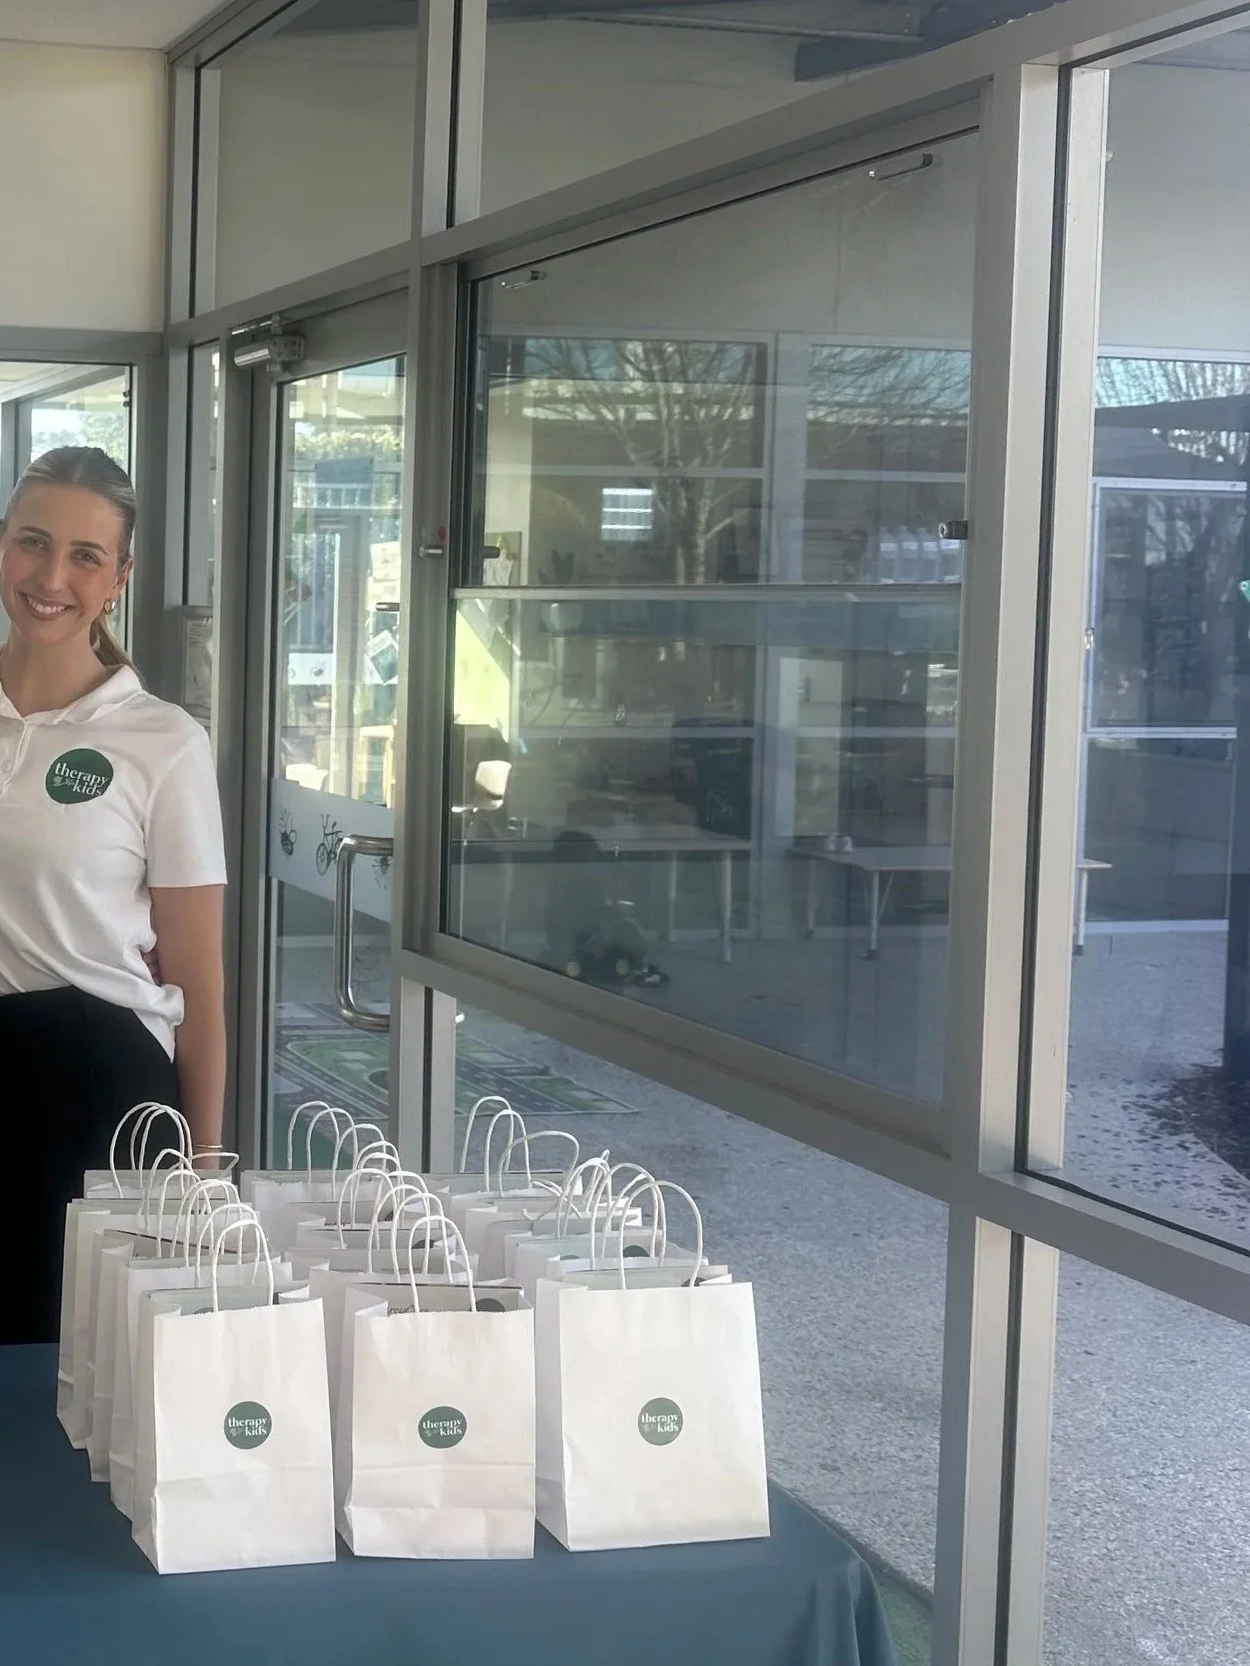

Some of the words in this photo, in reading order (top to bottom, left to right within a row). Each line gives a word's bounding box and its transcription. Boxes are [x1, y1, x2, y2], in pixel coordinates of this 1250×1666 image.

[55, 763, 108, 787] therapy
[73, 780, 102, 796] kids
[228, 1417, 267, 1429] therapy
[641, 1413, 679, 1425] therapy
[245, 1426, 267, 1436] kids
[657, 1422, 678, 1432] kids
